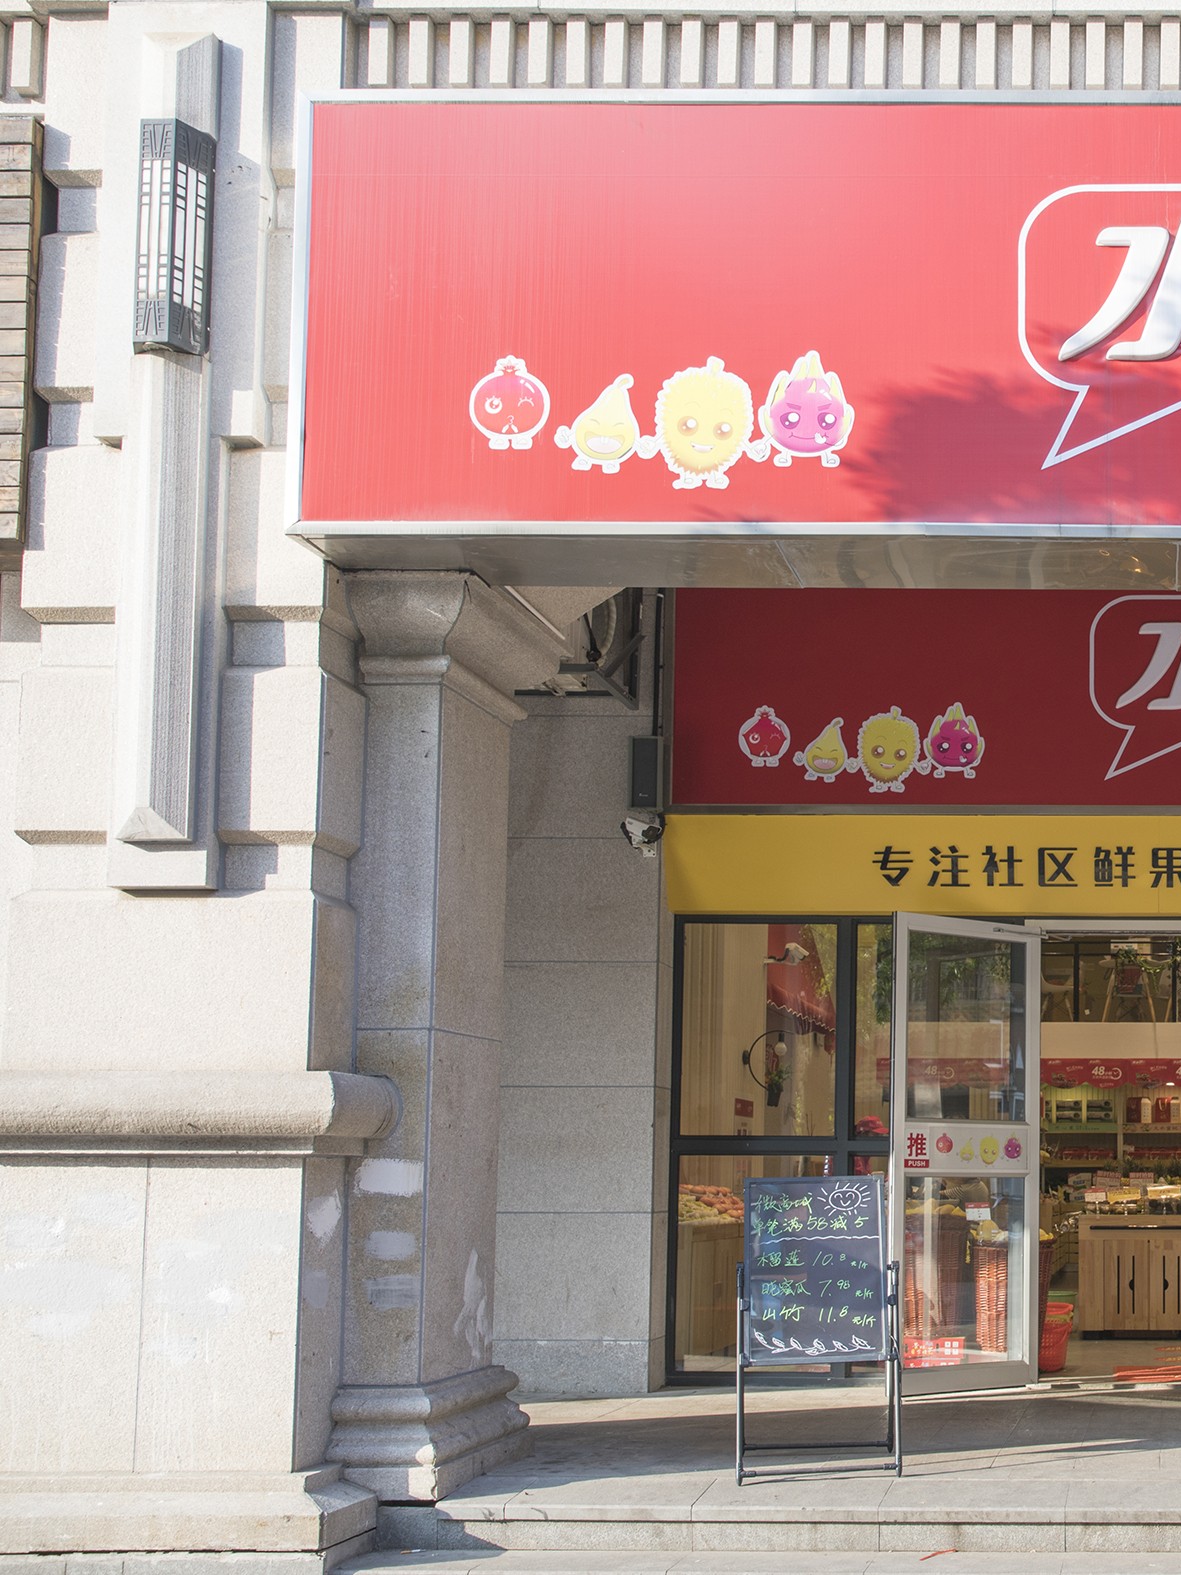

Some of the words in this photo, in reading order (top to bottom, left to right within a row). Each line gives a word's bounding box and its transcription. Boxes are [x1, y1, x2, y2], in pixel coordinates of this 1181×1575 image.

[907, 1132, 927, 1157] 推
[762, 1303, 805, 1322] 山竹
[818, 1305, 849, 1324] 11.8
